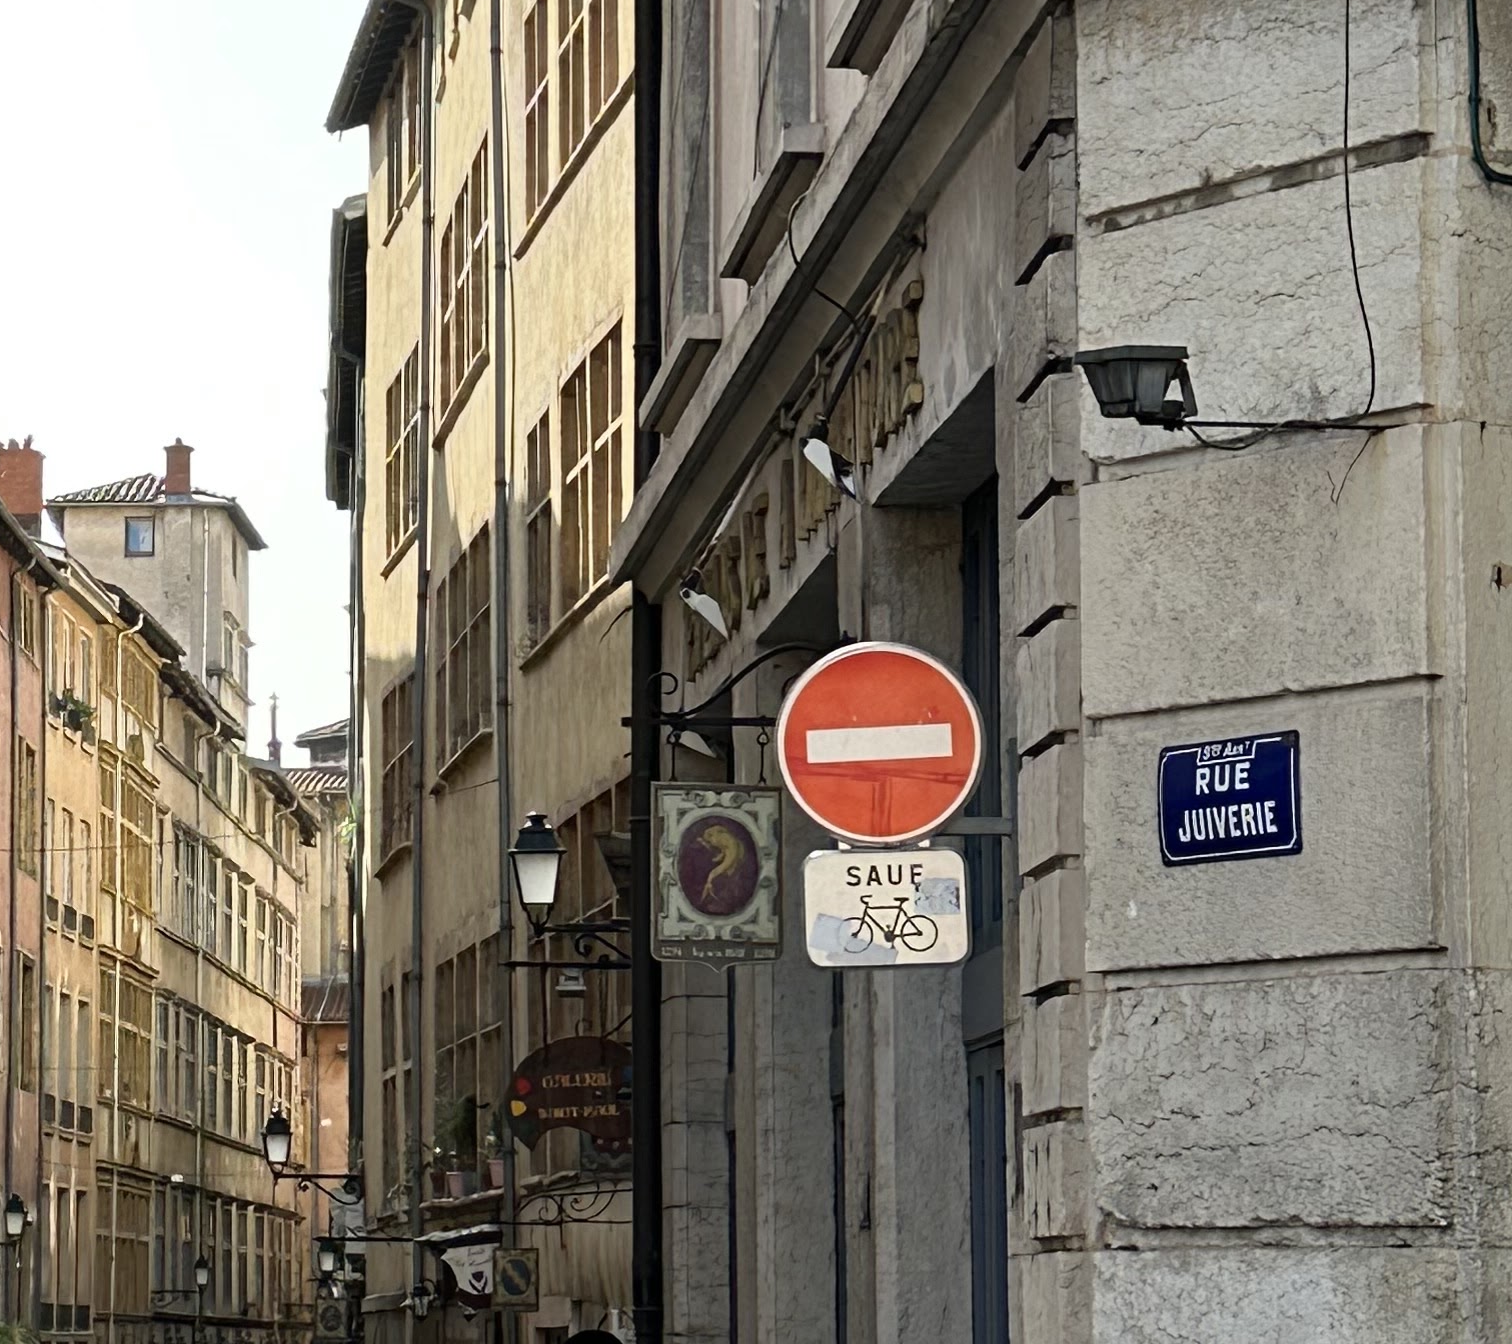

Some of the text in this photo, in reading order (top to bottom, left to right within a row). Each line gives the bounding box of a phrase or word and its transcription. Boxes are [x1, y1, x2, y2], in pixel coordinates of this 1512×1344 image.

[1195, 762, 1251, 795] RUE
[1178, 800, 1278, 843] JUIVERIE
[846, 863, 924, 887] SAUF
